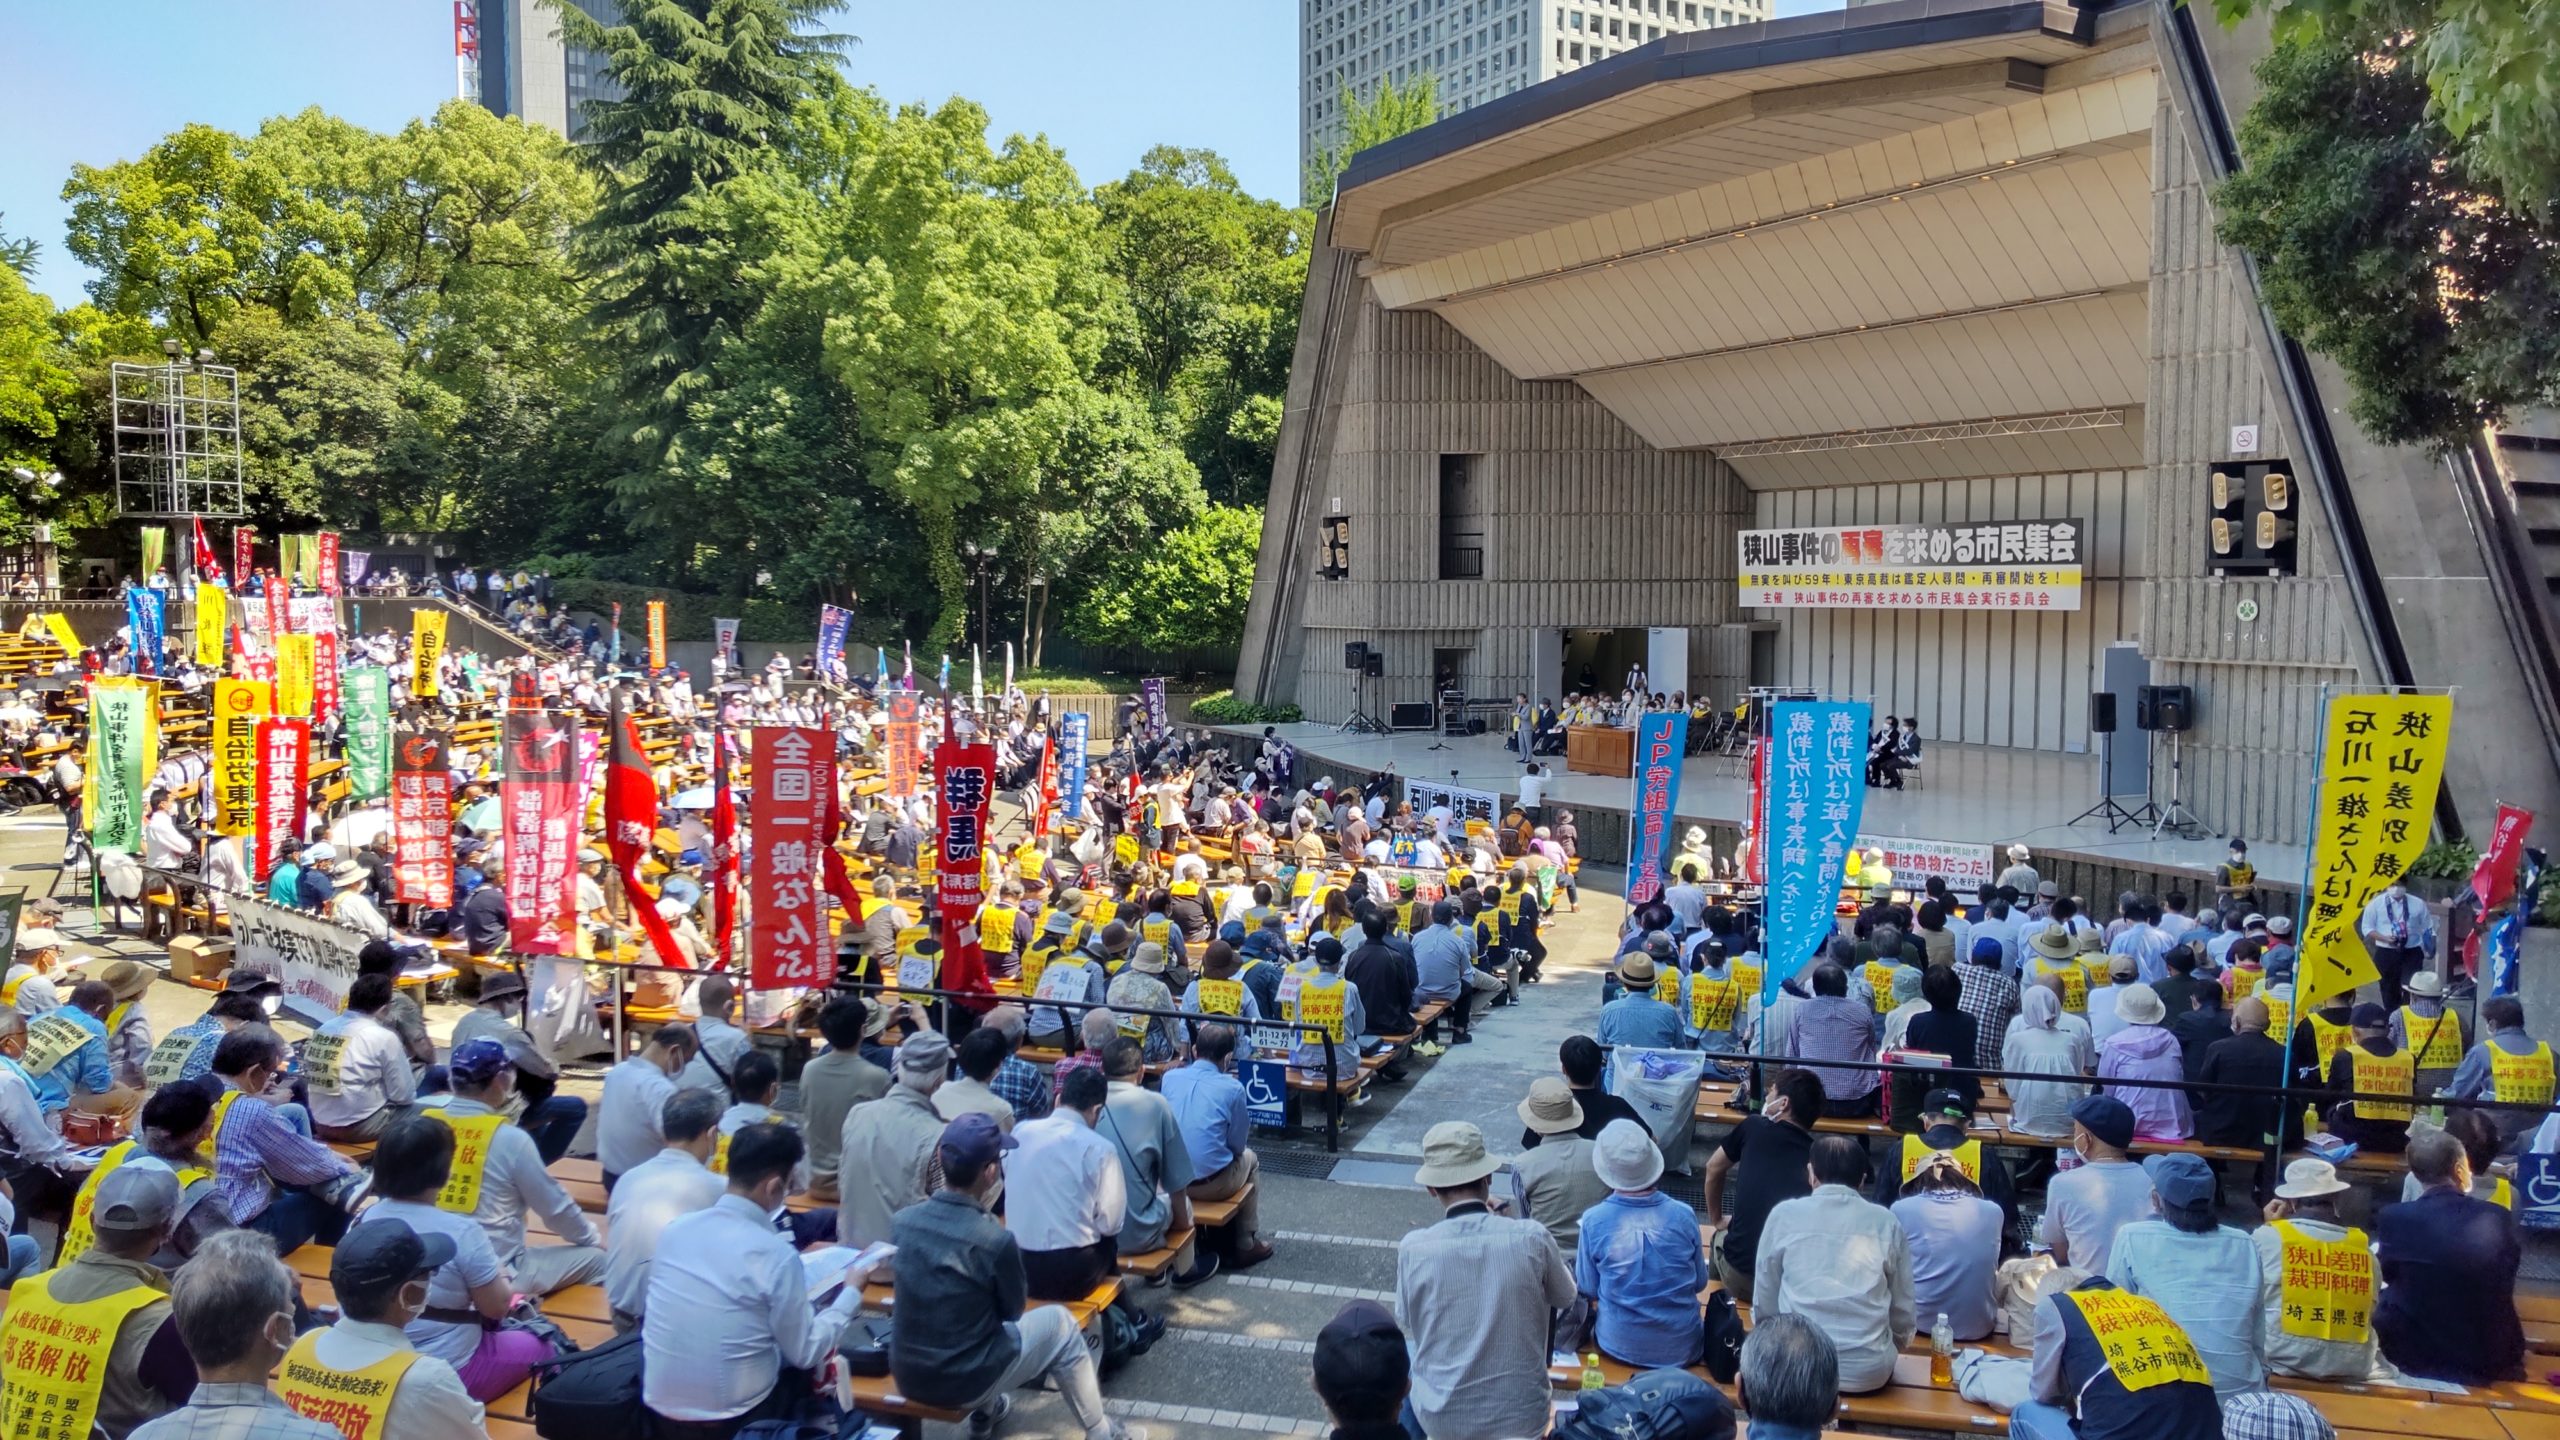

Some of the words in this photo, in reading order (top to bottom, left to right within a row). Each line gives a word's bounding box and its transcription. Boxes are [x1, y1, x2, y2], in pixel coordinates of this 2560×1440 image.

[1743, 523, 2076, 566] 狭山事件の再審を求める市民集会
[1062, 720, 1077, 811] 京都府連合会
[2287, 1245, 2369, 1274] 狭山差別
[2287, 1267, 2369, 1296] 裁判糾弾
[10, 1308, 102, 1346] 人権政策確立要求
[2286, 1304, 2366, 1328] 埼玉県連
[4, 1334, 91, 1384] 部落解放
[2115, 1351, 2204, 1379] 熊谷市協議会
